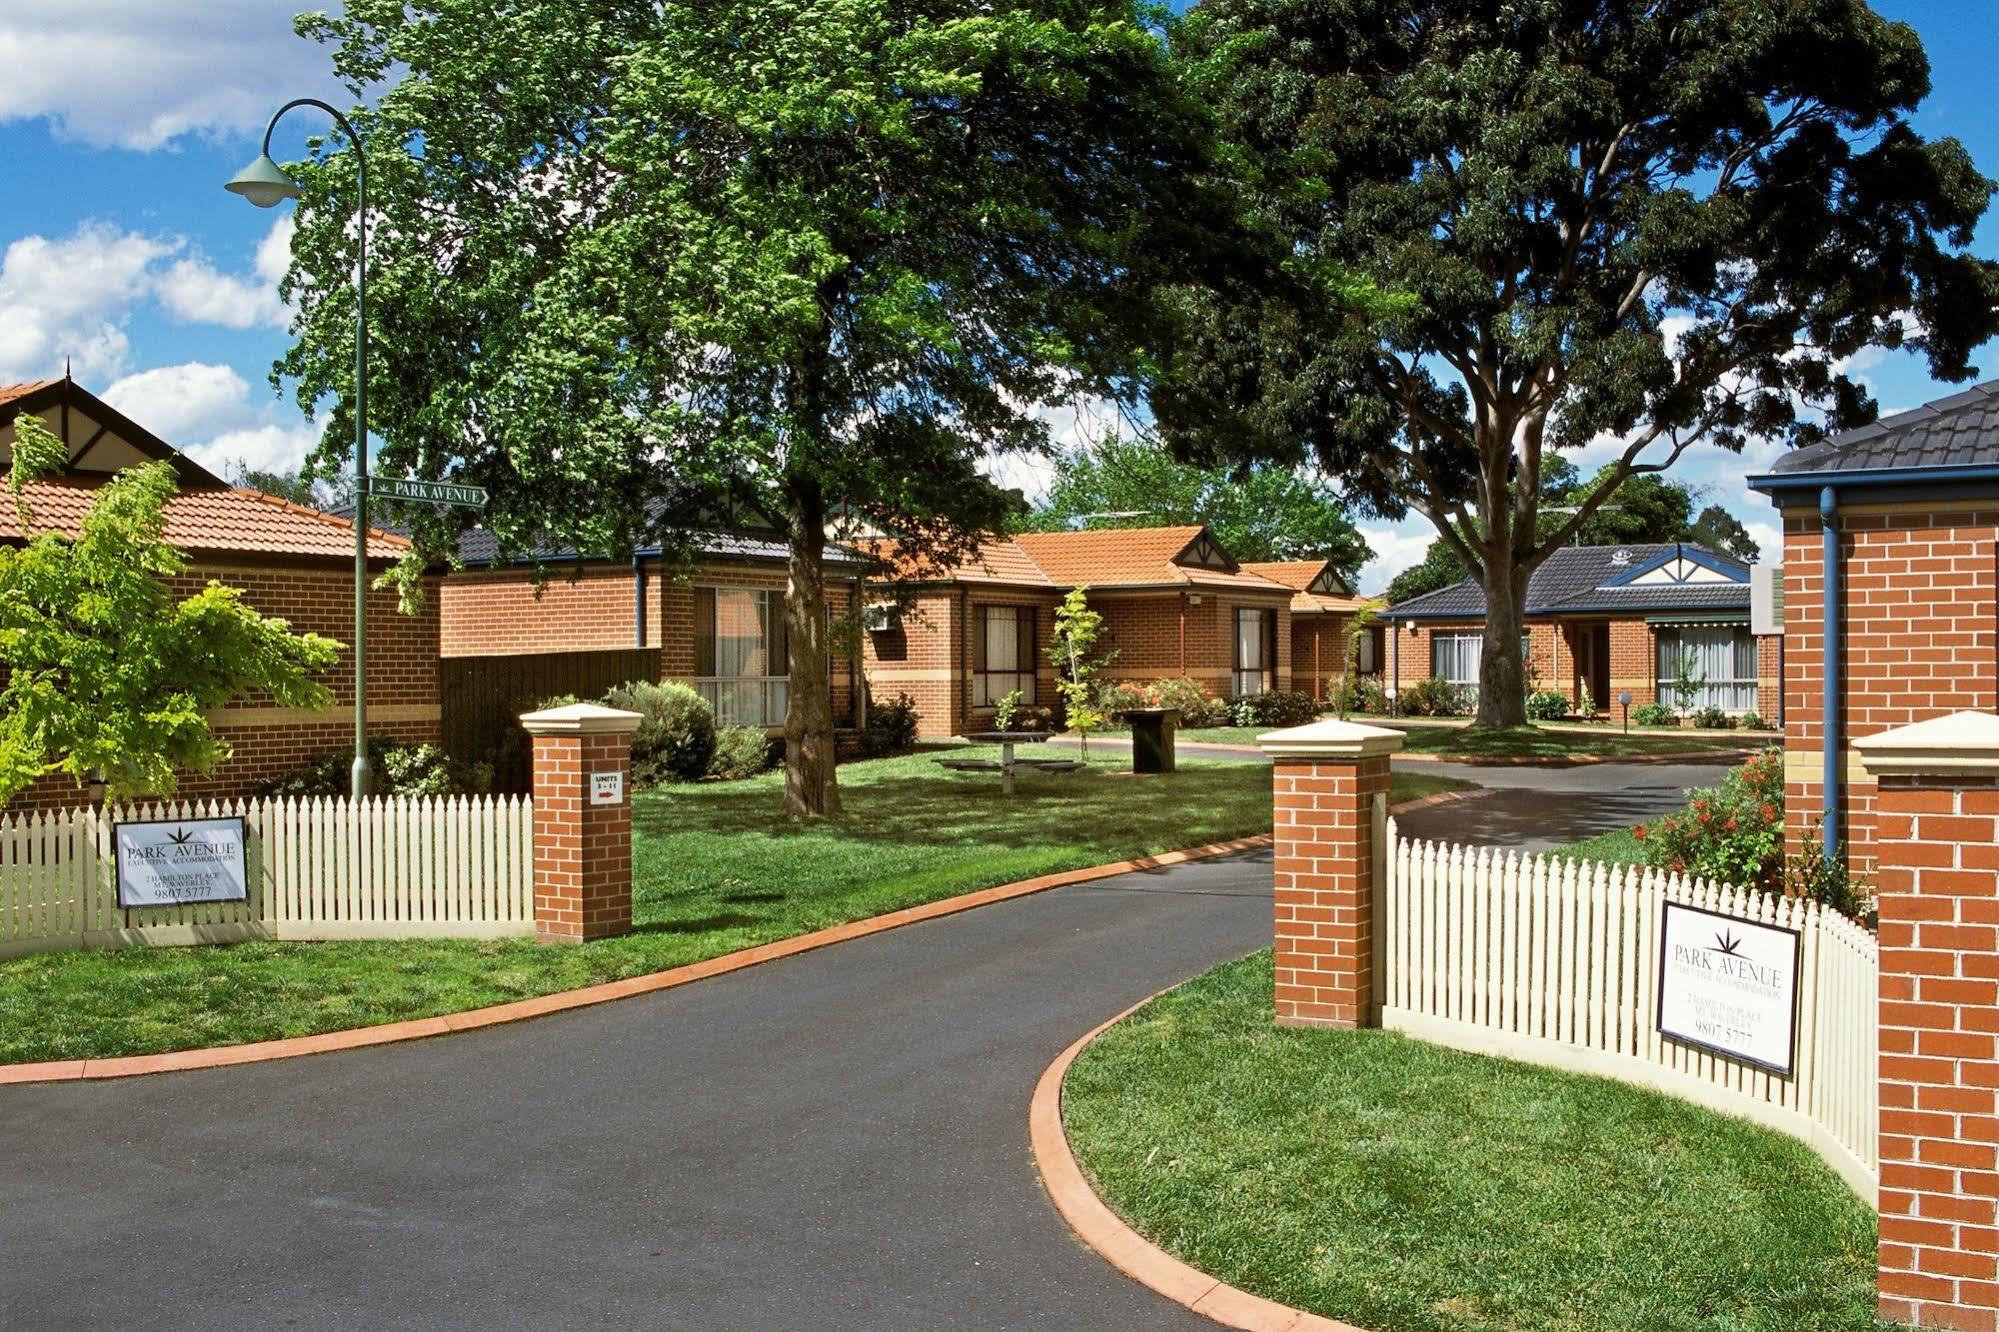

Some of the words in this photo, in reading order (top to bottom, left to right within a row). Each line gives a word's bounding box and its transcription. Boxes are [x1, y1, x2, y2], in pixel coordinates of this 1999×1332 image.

[394, 481, 428, 498] PARK
[430, 486, 480, 503] AVENUE
[128, 846, 167, 859] PARK
[174, 842, 236, 858] AVENUE
[172, 855, 236, 865] ACCOMMODATION
[151, 873, 193, 882] HAMILTON
[194, 872, 219, 880] PLACE
[154, 888, 182, 899] 9807
[184, 886, 212, 898] 5777
[1675, 944, 1711, 970] PARK
[1718, 956, 1783, 989] AVENUE
[1695, 1019, 1721, 1040] 9807
[1725, 1027, 1753, 1048] 5777
